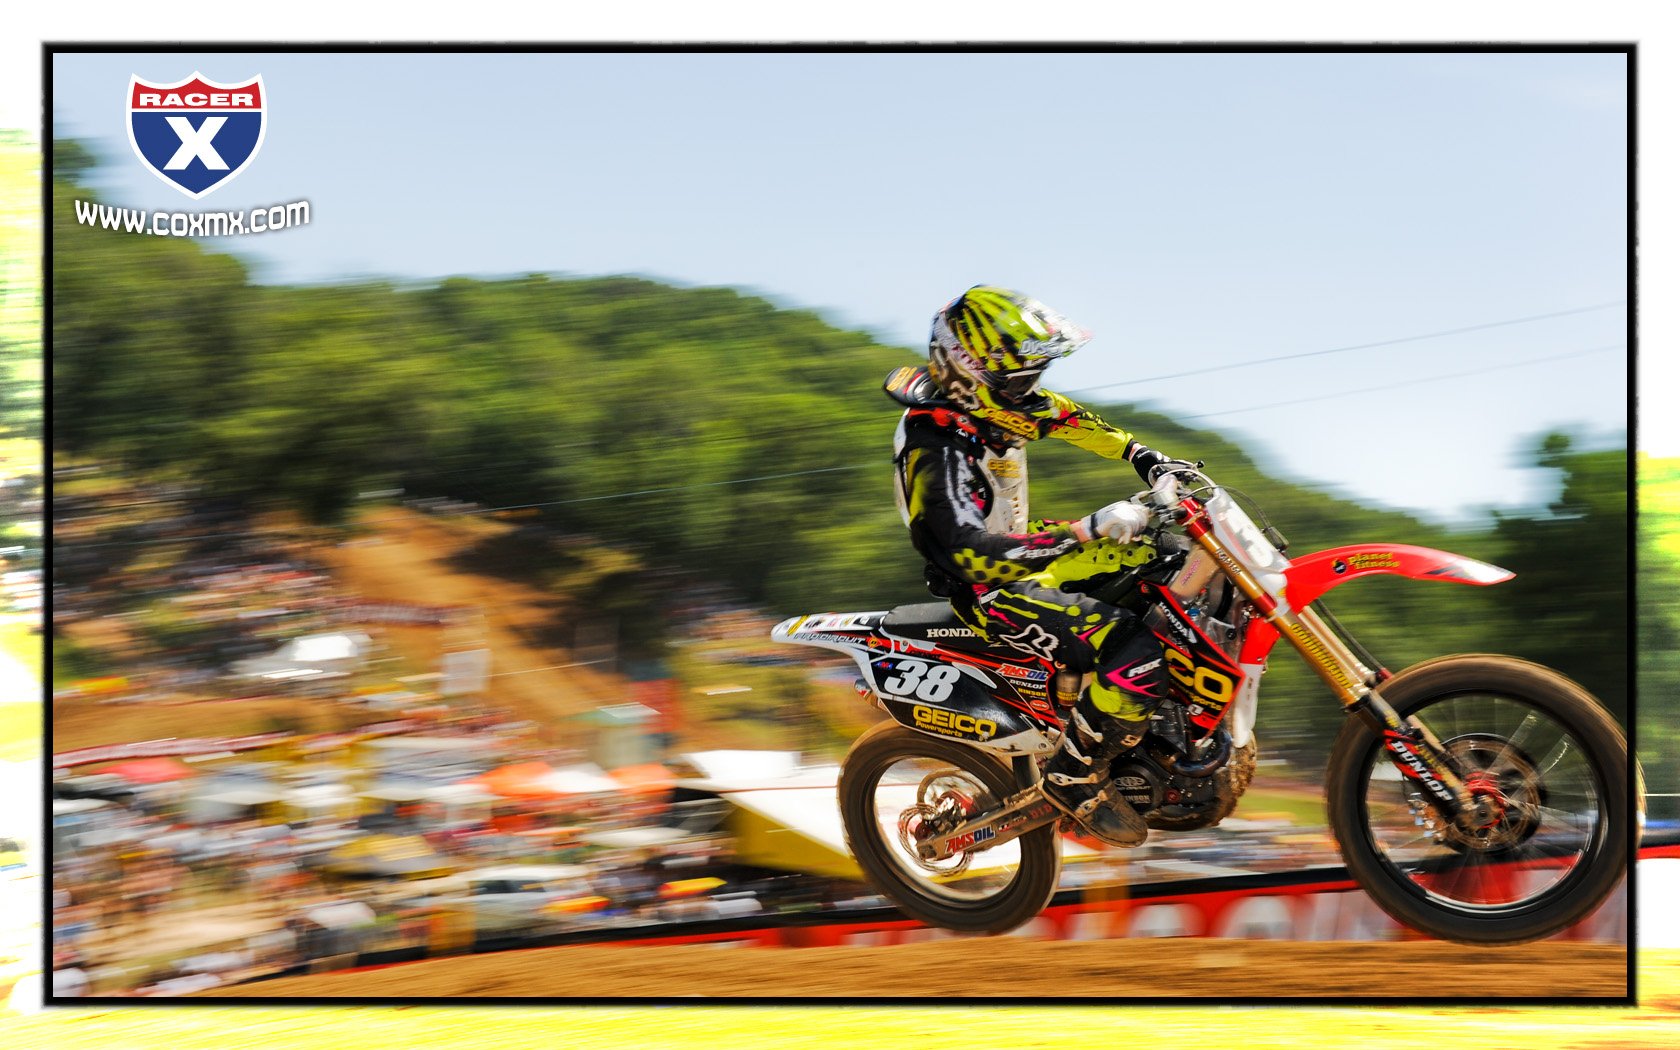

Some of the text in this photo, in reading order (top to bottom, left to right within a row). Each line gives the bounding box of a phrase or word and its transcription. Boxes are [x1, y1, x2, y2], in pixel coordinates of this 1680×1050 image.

[984, 407, 1036, 432] GEICO
[1159, 601, 1189, 637] HONDA
[884, 660, 961, 703] 38
[996, 663, 1049, 681] AMSOIL
[1009, 679, 1047, 690] DUNLOP
[913, 704, 997, 738] GEICO
[915, 720, 963, 738] Powersports
[1390, 740, 1454, 801] DUNLOP
[945, 824, 996, 855] AMSOIL
